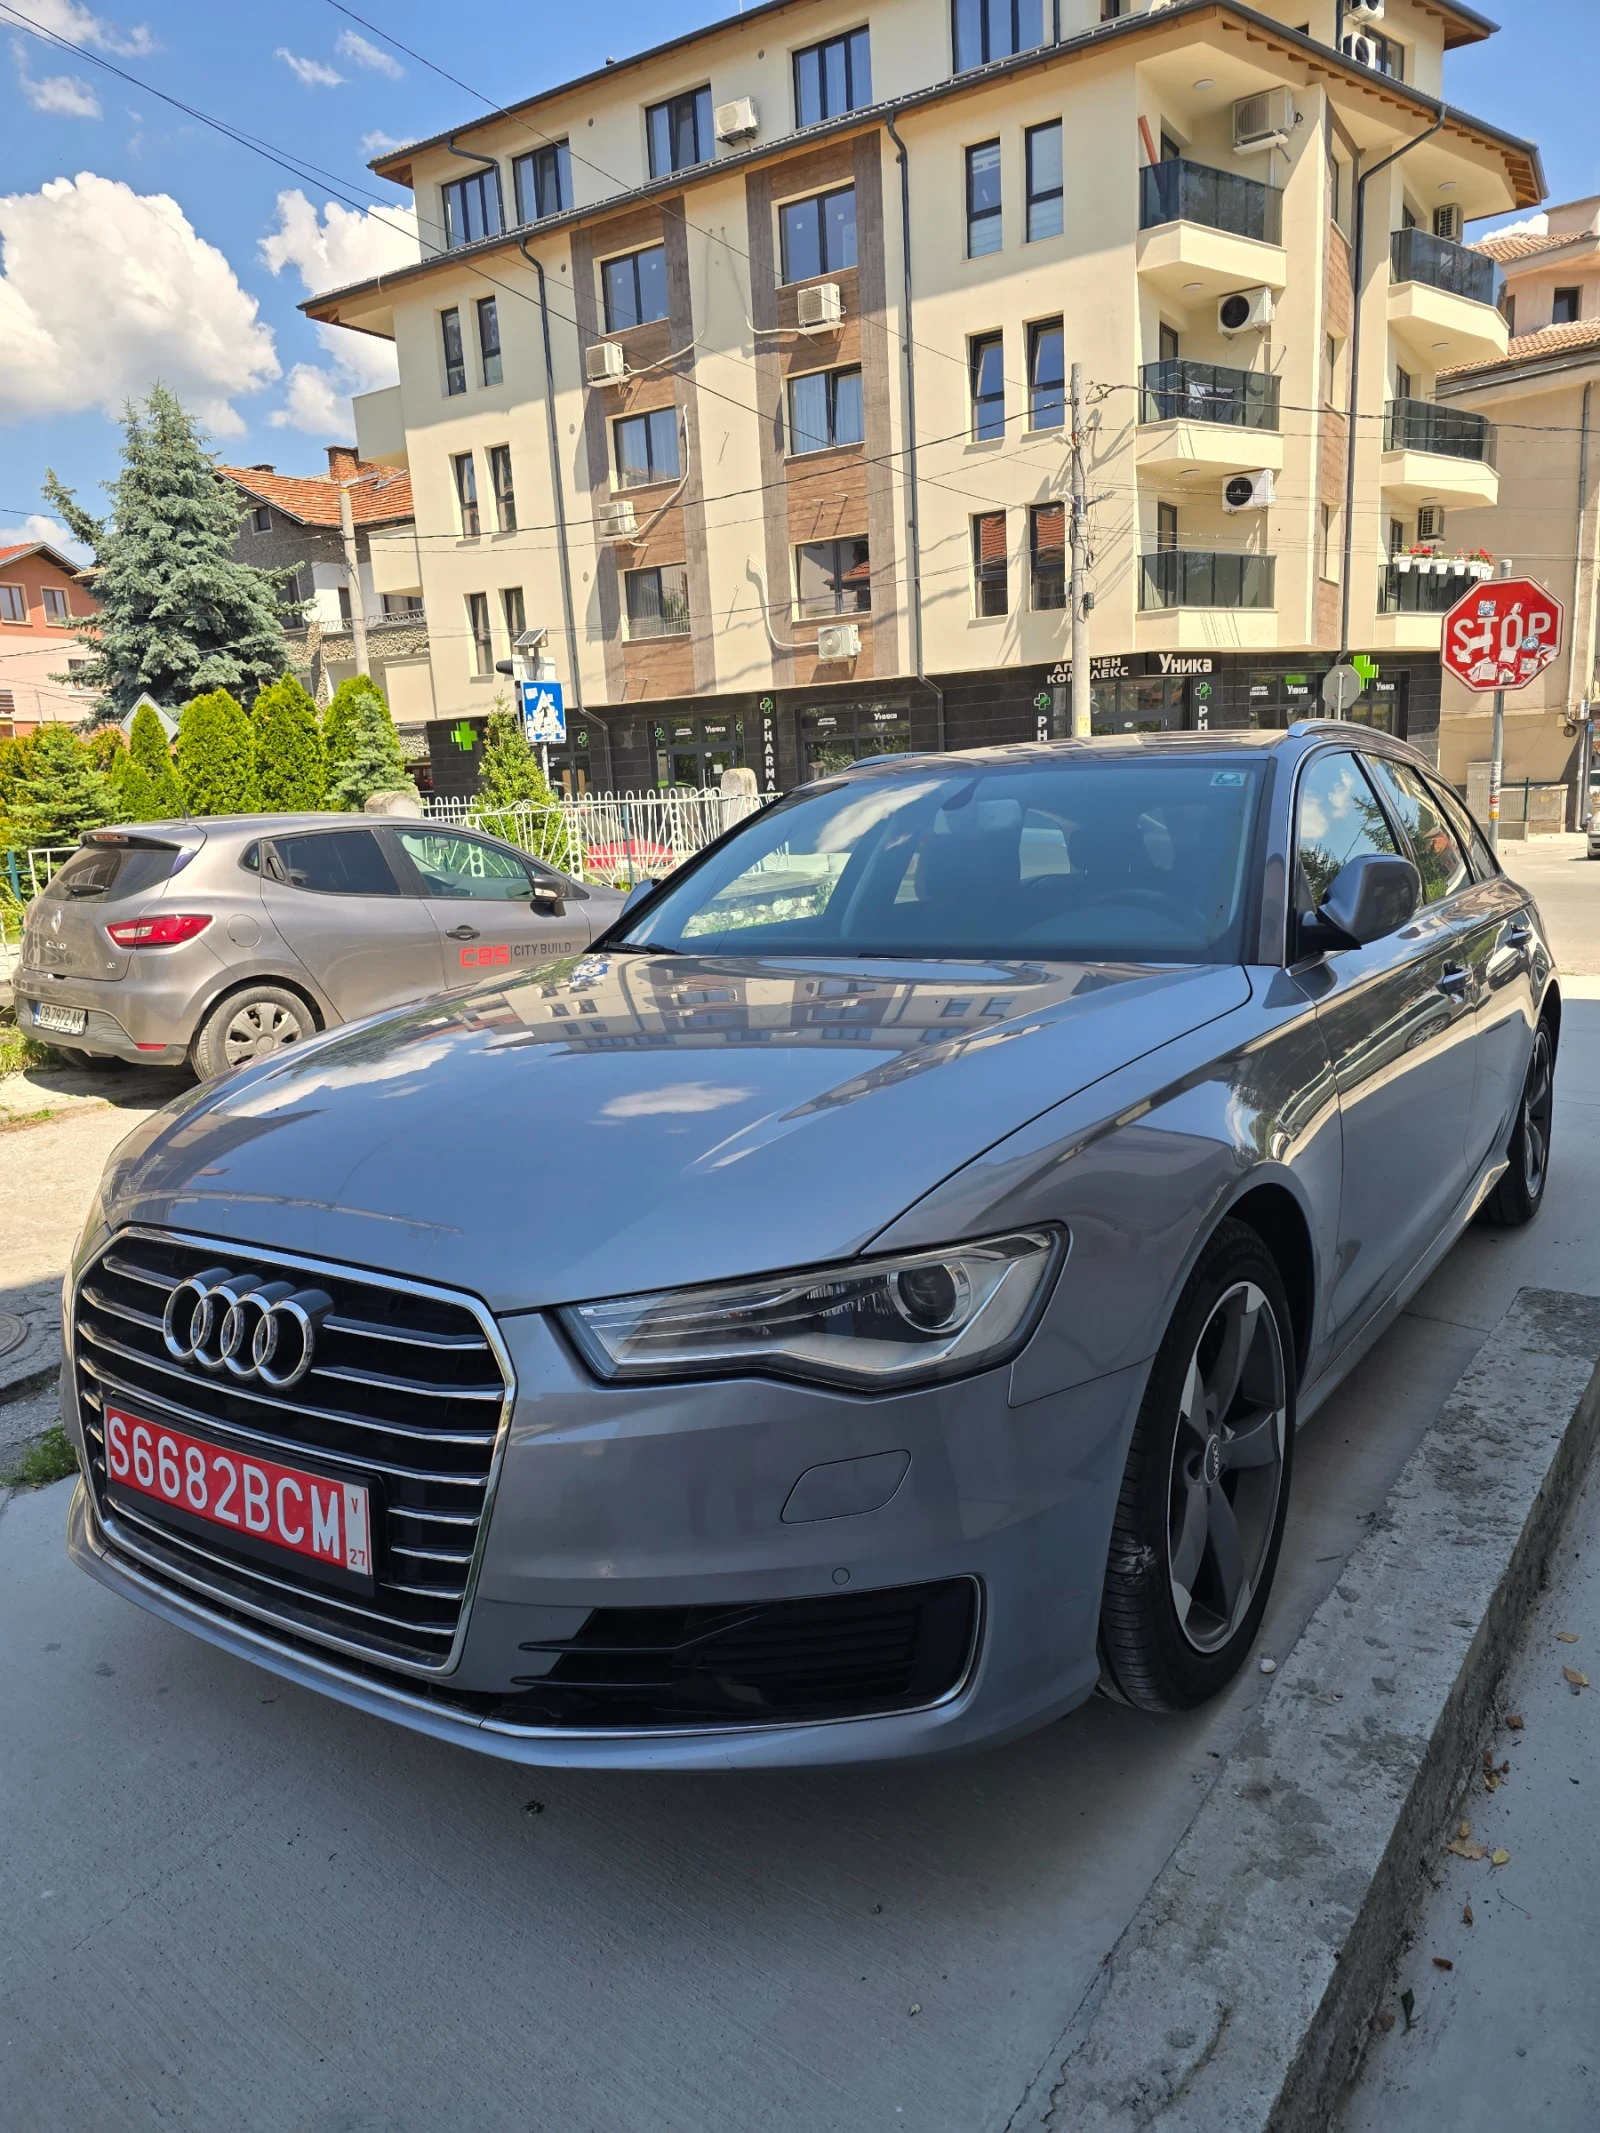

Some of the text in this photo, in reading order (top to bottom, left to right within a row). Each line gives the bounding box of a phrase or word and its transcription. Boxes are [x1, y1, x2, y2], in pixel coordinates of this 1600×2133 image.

[1452, 611, 1551, 656] STOP
[1053, 657, 1121, 674] АПЧЕН
[1158, 653, 1213, 674] Уника
[763, 718, 776, 791] PHARMA
[460, 942, 572, 968] CBS CITY BUILD
[108, 1416, 341, 1560] S6682BCM
[351, 1497, 358, 1514] V
[350, 1548, 366, 1567] 27
